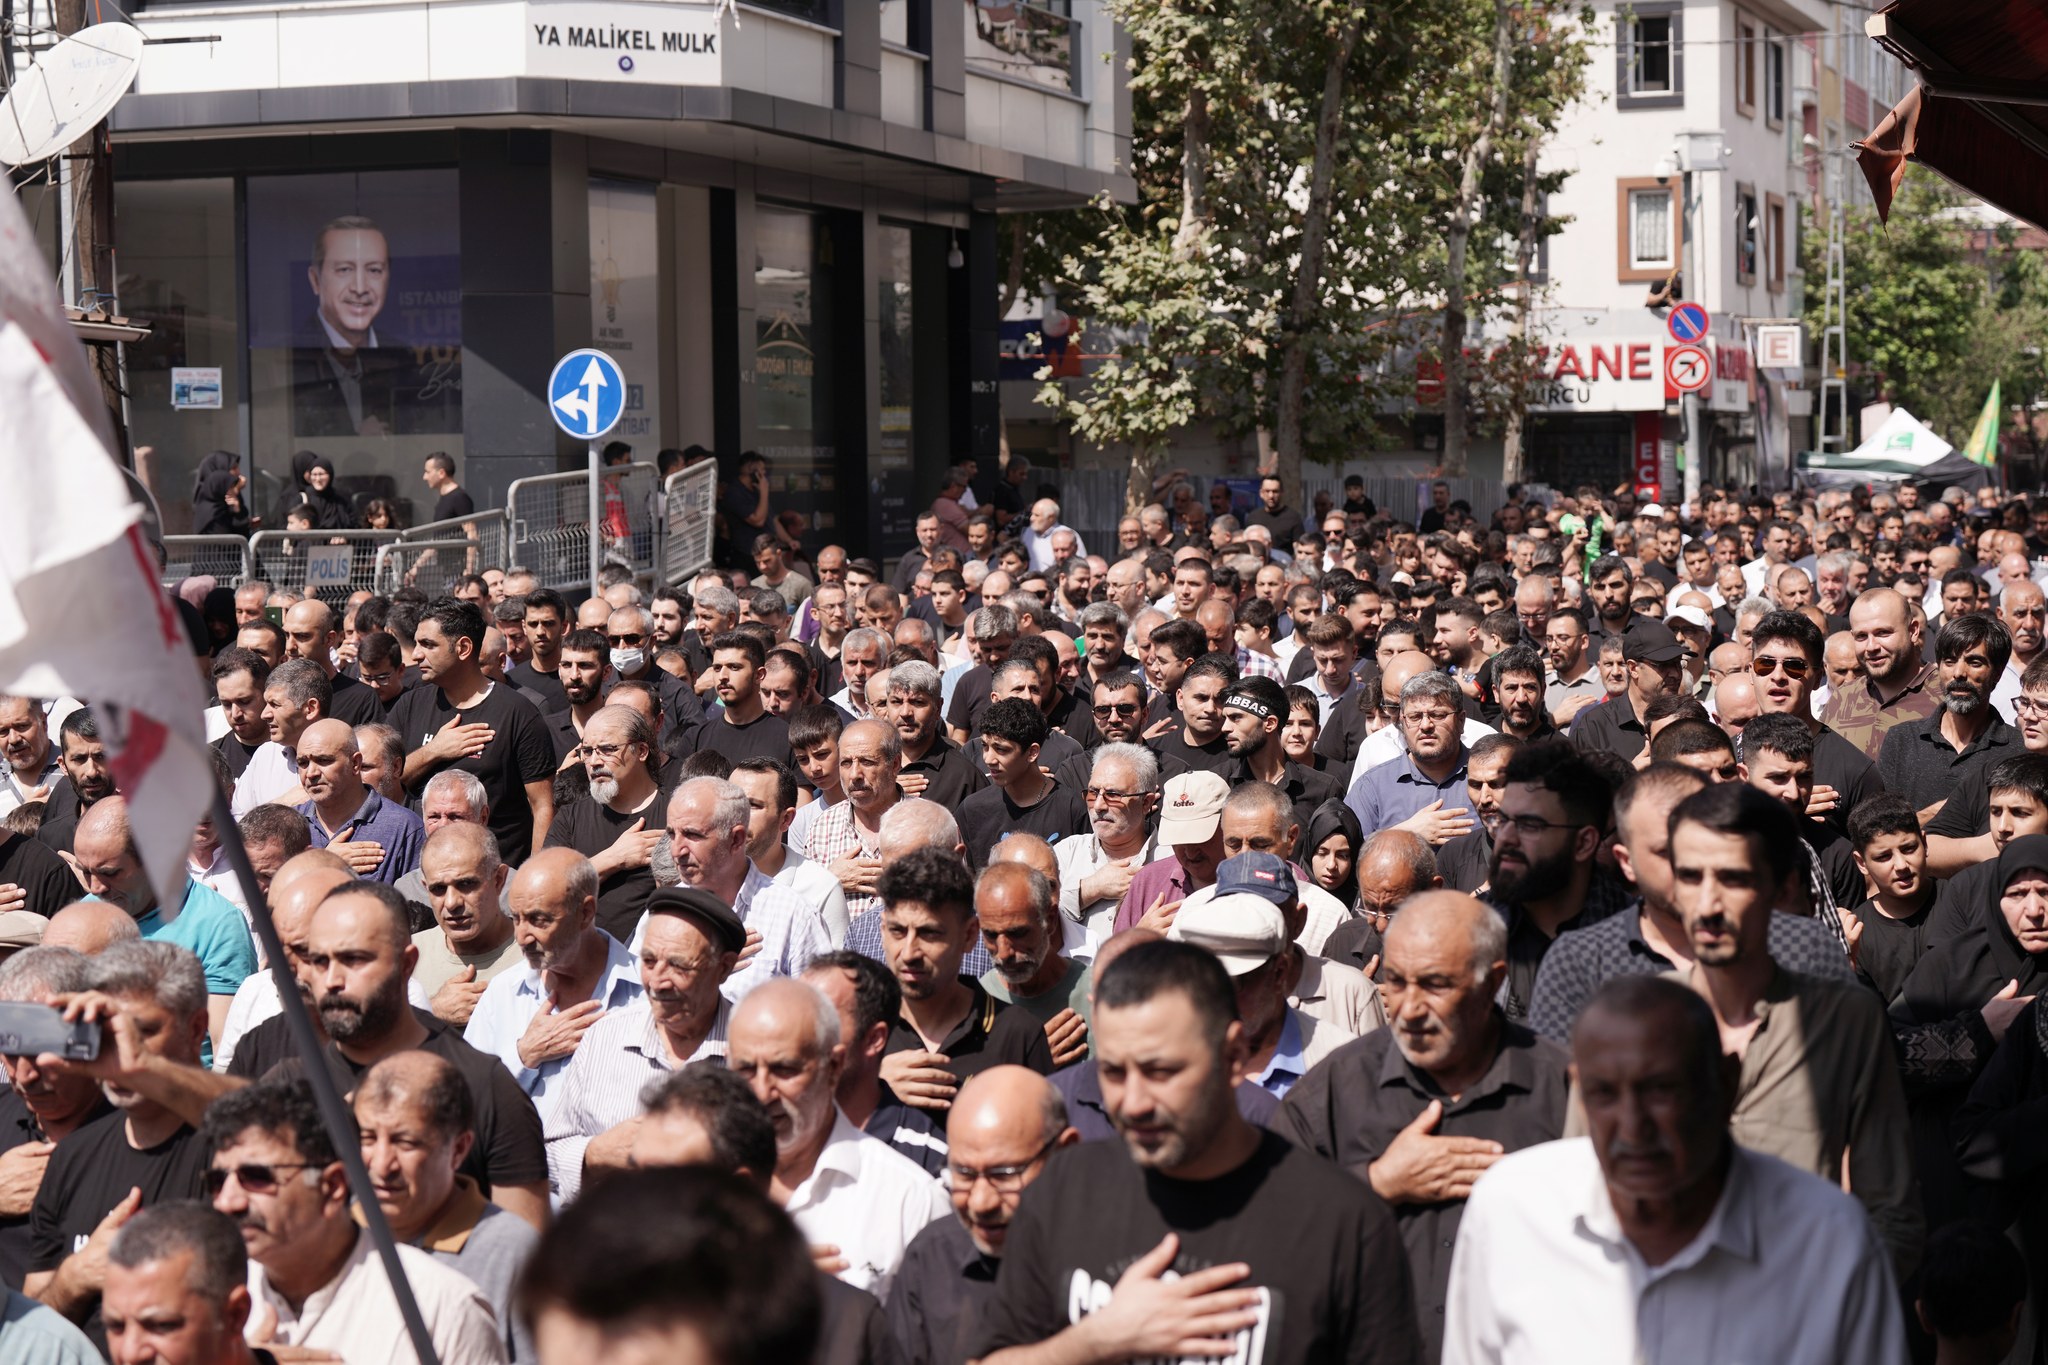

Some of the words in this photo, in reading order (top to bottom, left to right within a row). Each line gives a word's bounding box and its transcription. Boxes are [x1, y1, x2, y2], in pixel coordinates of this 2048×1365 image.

[535, 24, 561, 46] YA
[568, 23, 656, 50] MALİKEL
[662, 32, 716, 53] MULK
[1770, 336, 1789, 360] E
[971, 380, 997, 393] NO:7
[1225, 695, 1269, 715] ABBAS
